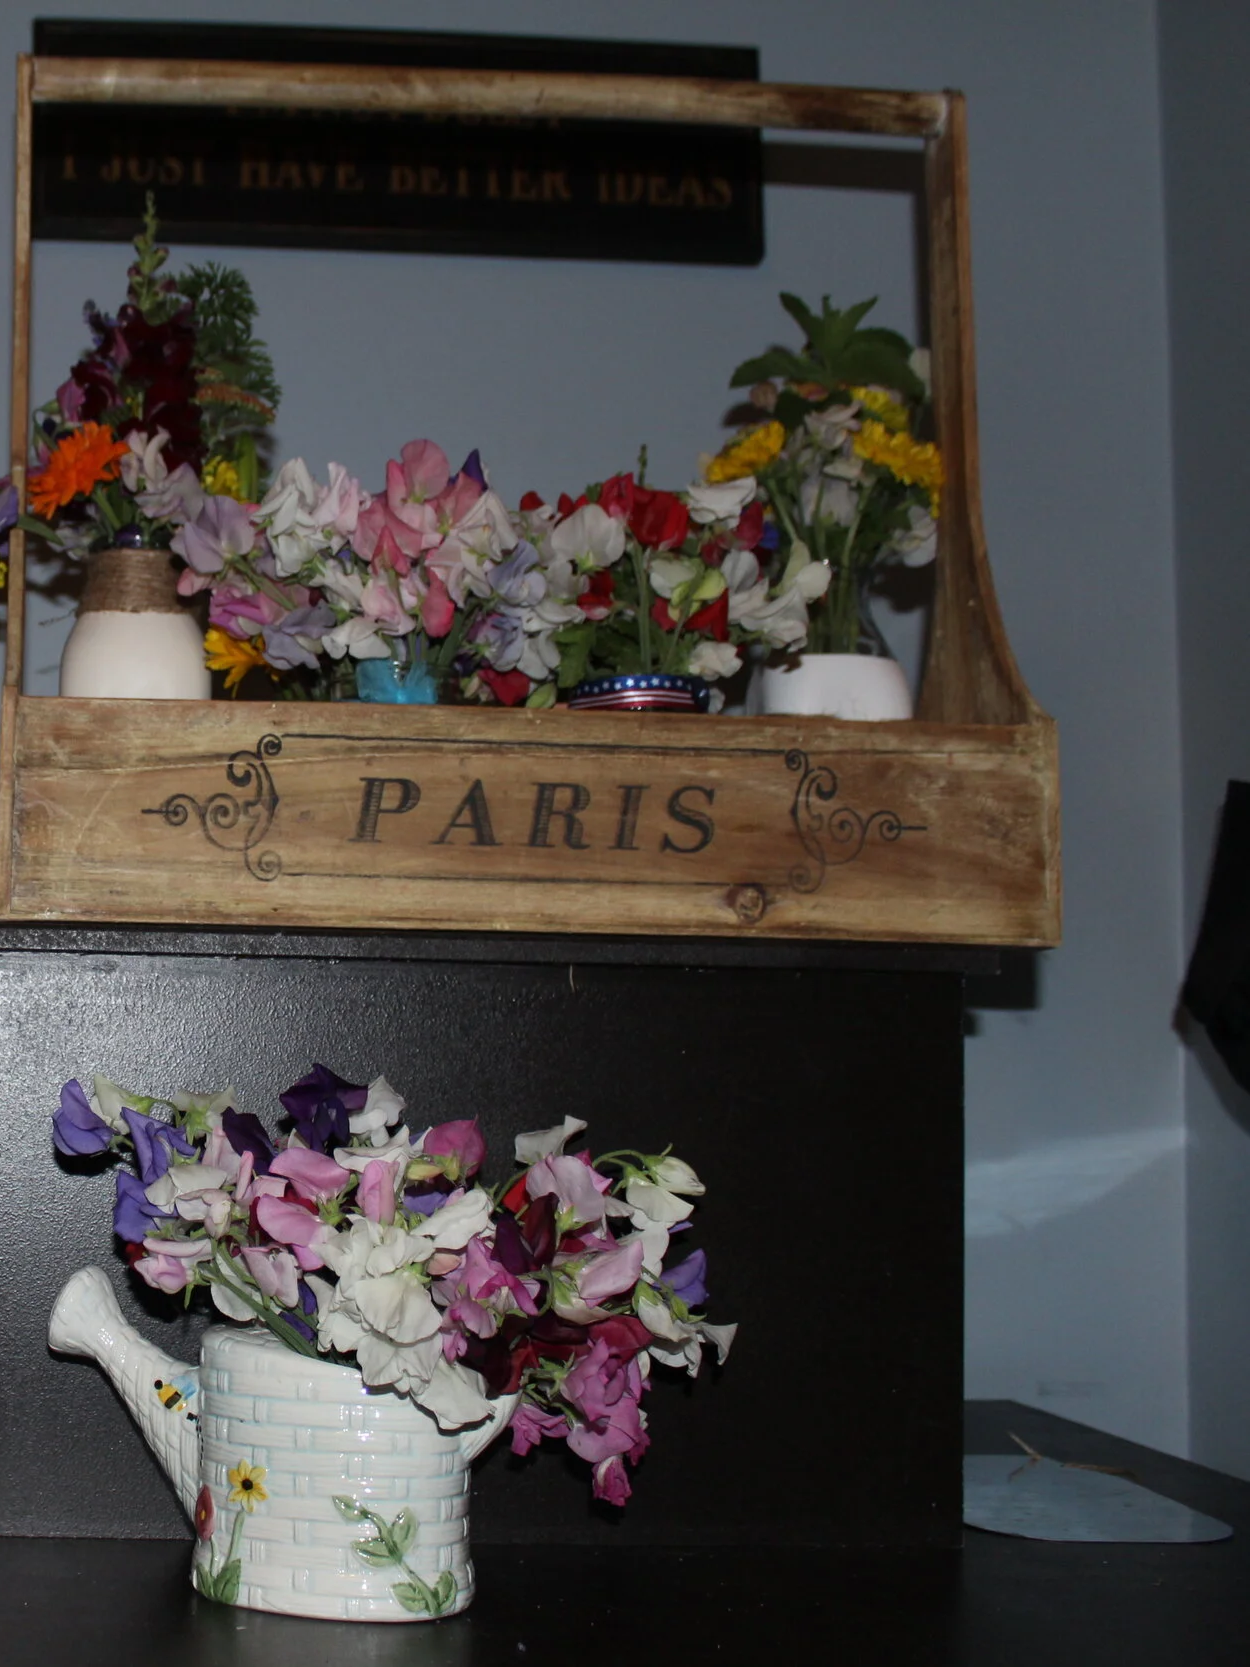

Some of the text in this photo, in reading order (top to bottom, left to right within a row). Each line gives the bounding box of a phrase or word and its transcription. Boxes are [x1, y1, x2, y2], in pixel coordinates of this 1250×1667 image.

[237, 143, 366, 193] HAVE
[597, 158, 734, 210] IDEAS
[347, 776, 718, 854] PARIS
